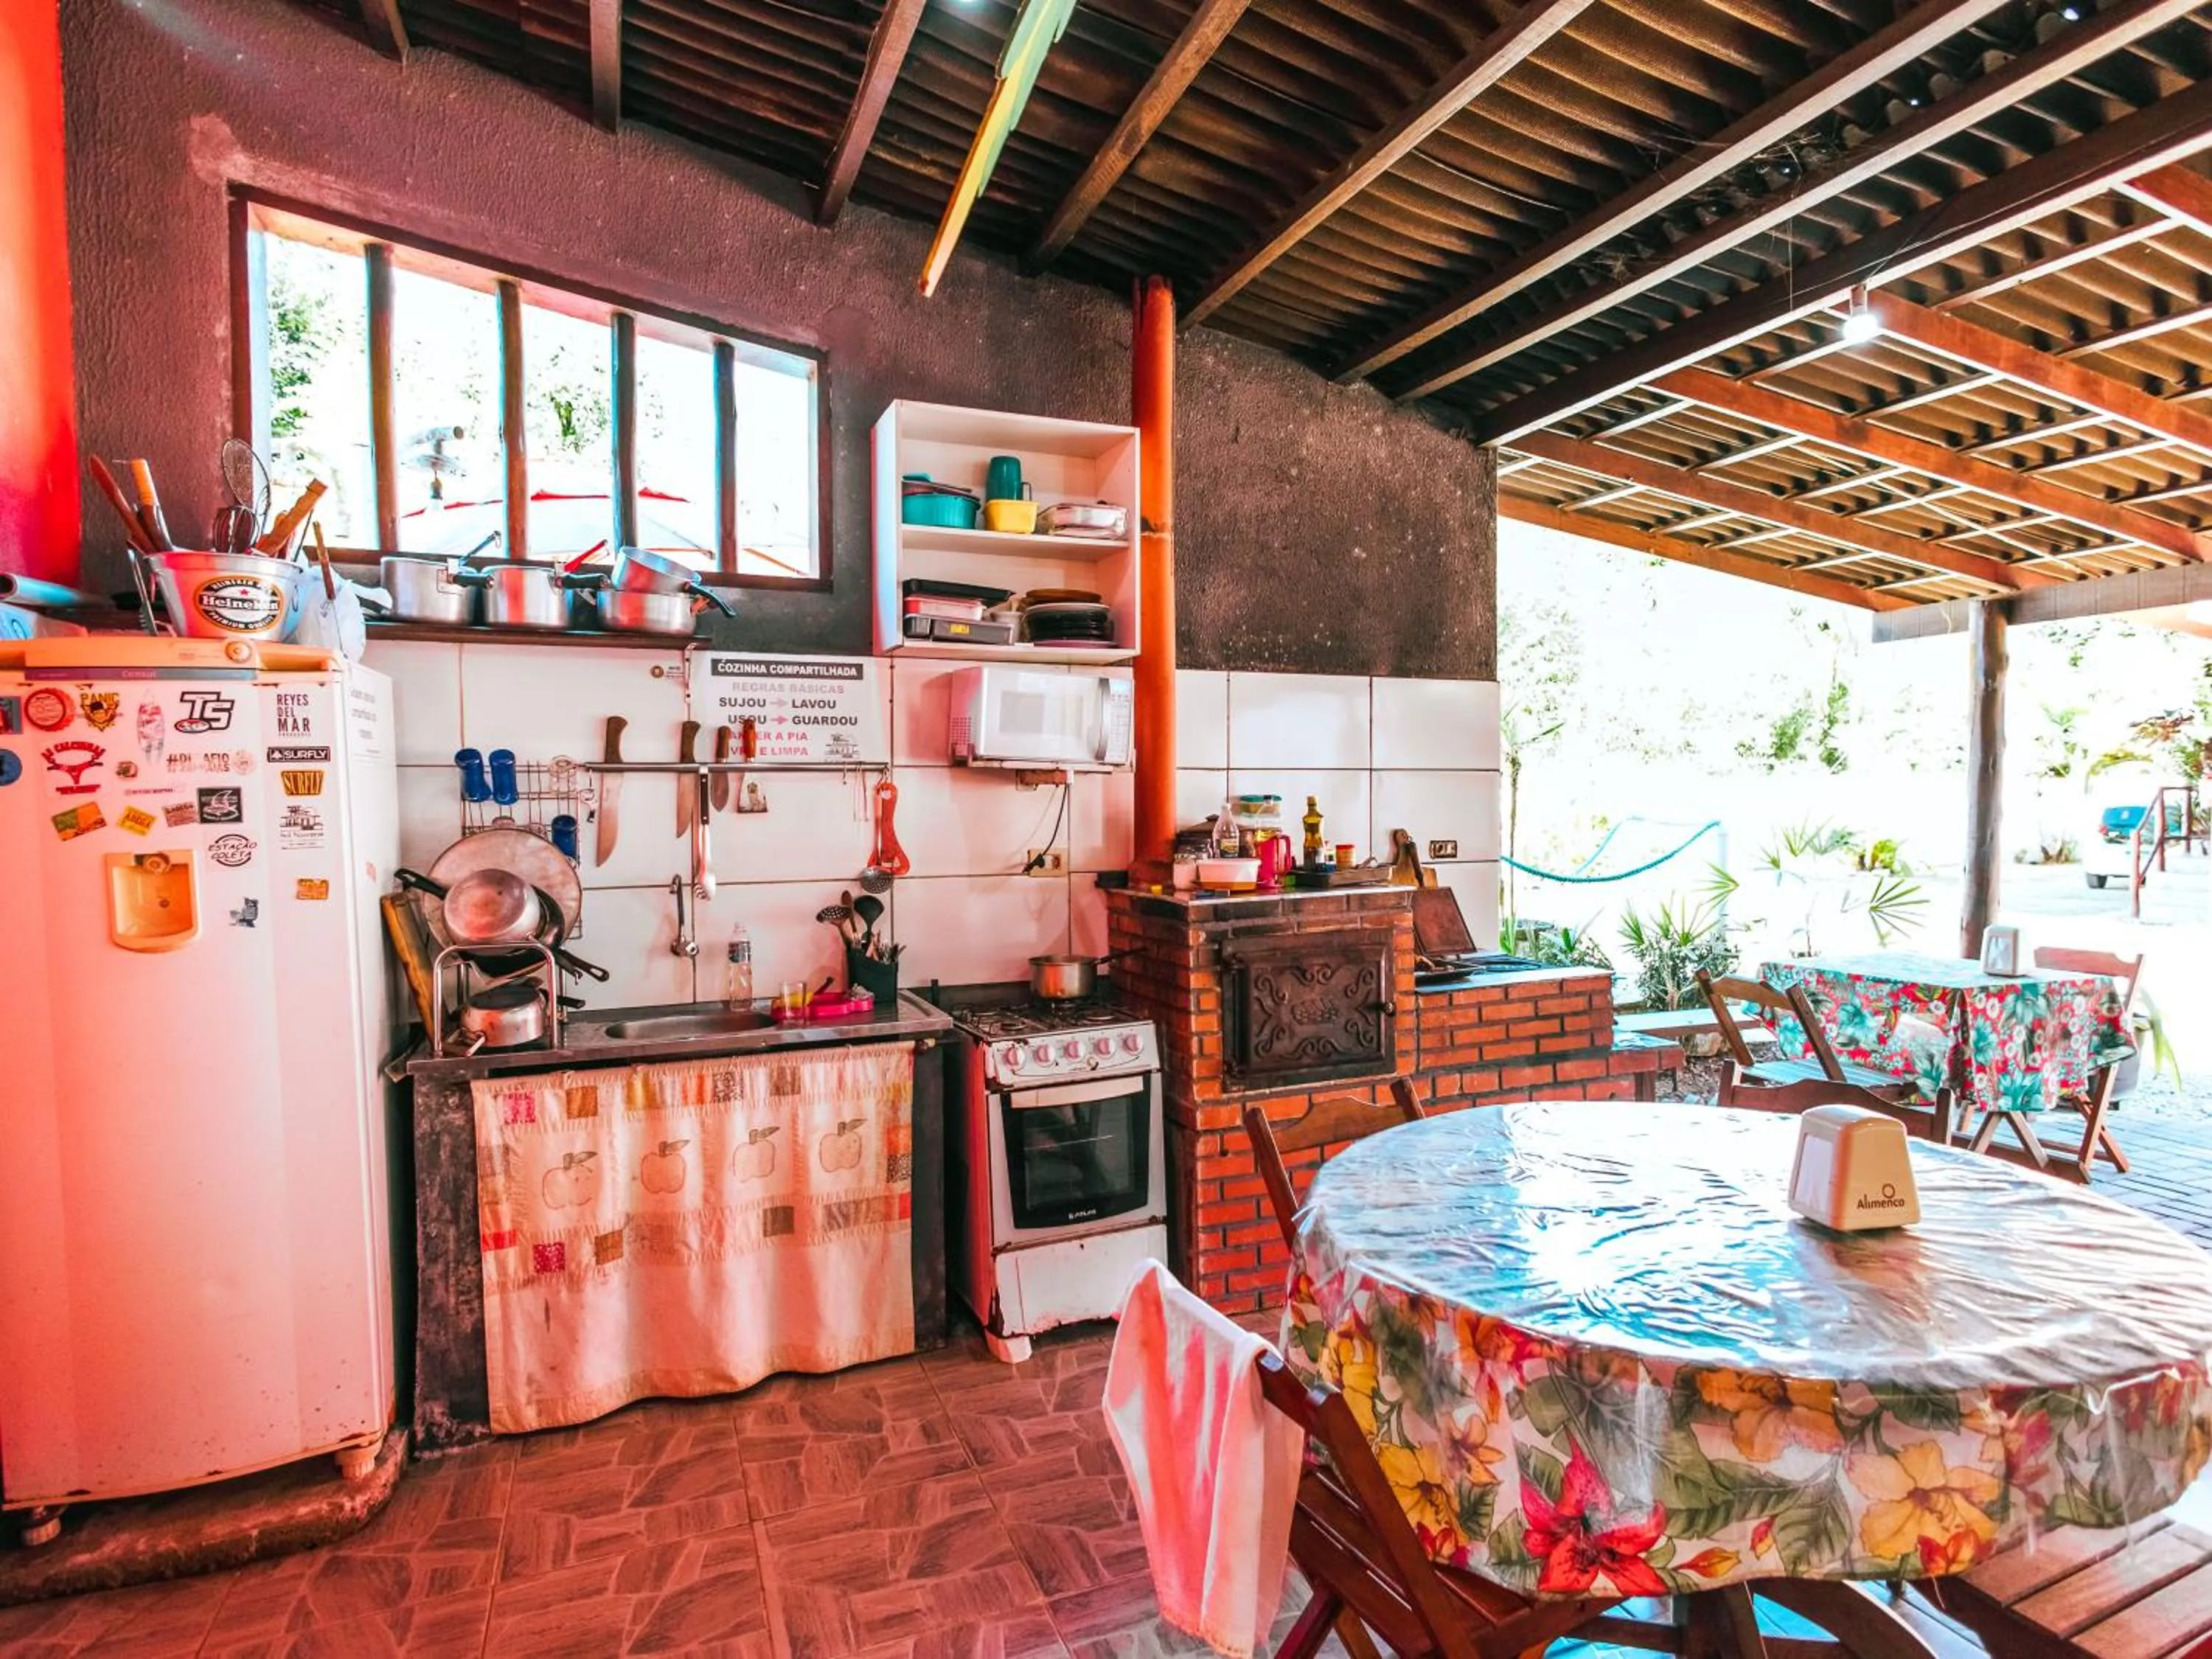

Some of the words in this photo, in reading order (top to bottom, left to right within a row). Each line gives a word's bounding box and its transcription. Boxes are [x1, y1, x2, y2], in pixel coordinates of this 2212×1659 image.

[203, 594, 278, 611] Heineken
[717, 663, 767, 673] COZINHA
[770, 664, 858, 676] COMPARTILHADA
[732, 681, 786, 692] REGRAS
[276, 694, 309, 706] REYES
[719, 697, 766, 708] SUJOU
[791, 699, 837, 709] LAVOU
[276, 706, 296, 717] DEL
[278, 717, 310, 732] MAR
[792, 716, 858, 726] GUARDOU
[776, 731, 784, 740] A
[787, 732, 808, 741] PIA
[284, 750, 327, 759] SURFLY
[759, 747, 767, 756] E
[771, 747, 809, 756] LIMPA
[282, 771, 323, 795] SURFLY
